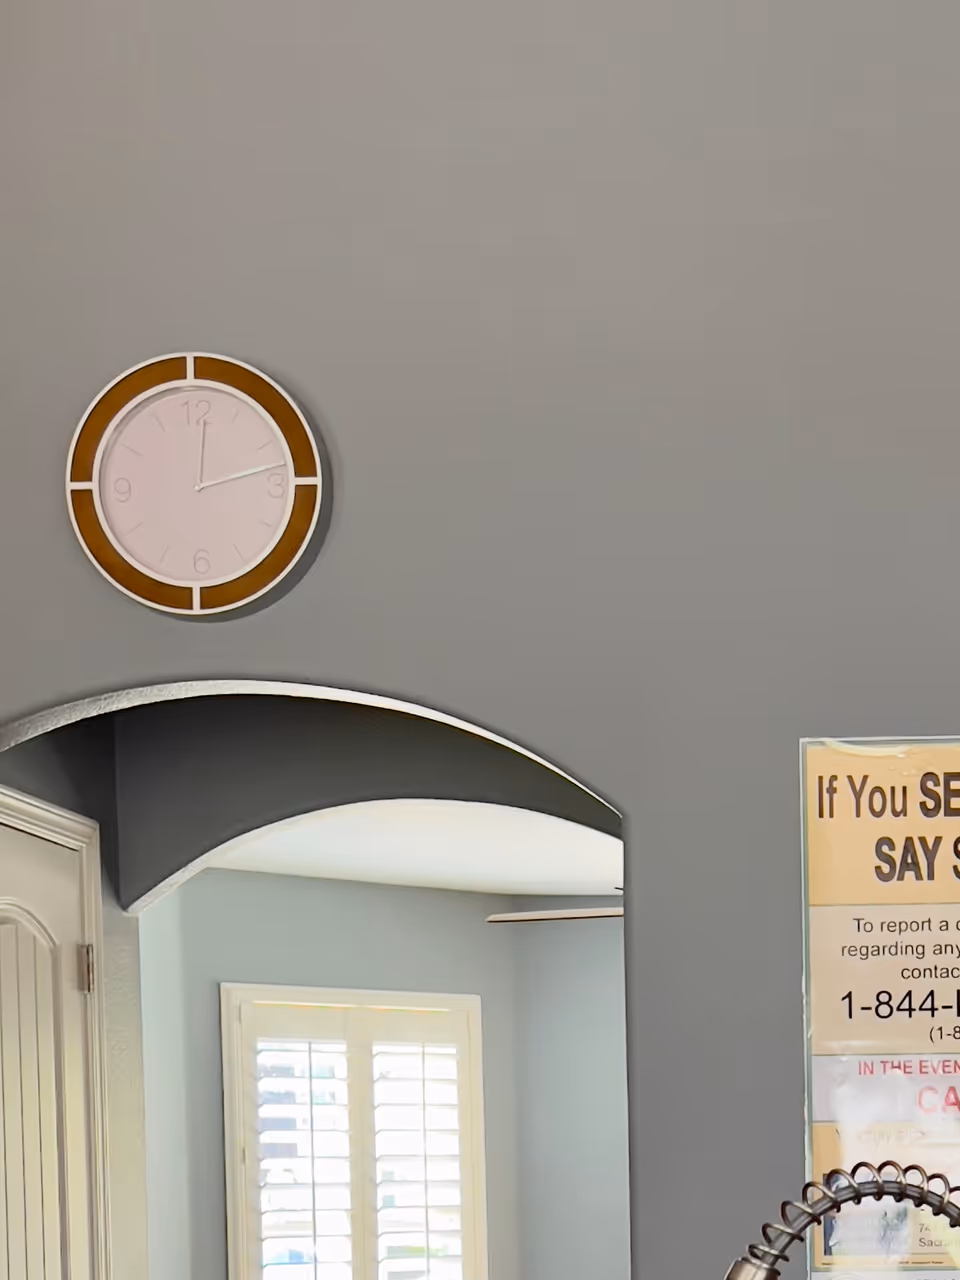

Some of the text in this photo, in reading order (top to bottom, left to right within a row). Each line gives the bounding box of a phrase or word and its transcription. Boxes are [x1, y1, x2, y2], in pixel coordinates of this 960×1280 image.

[181, 399, 213, 426] 12
[113, 476, 132, 503] 9
[266, 472, 285, 499] 3
[193, 548, 211, 574] 6
[816, 775, 838, 819] If
[846, 774, 908, 818] You
[874, 835, 943, 882] SAY
[852, 917, 874, 933] To
[880, 916, 933, 936] report
[939, 919, 950, 932] a
[841, 941, 926, 961] regarding
[857, 1060, 875, 1076] IN
[879, 1059, 913, 1076] THE
